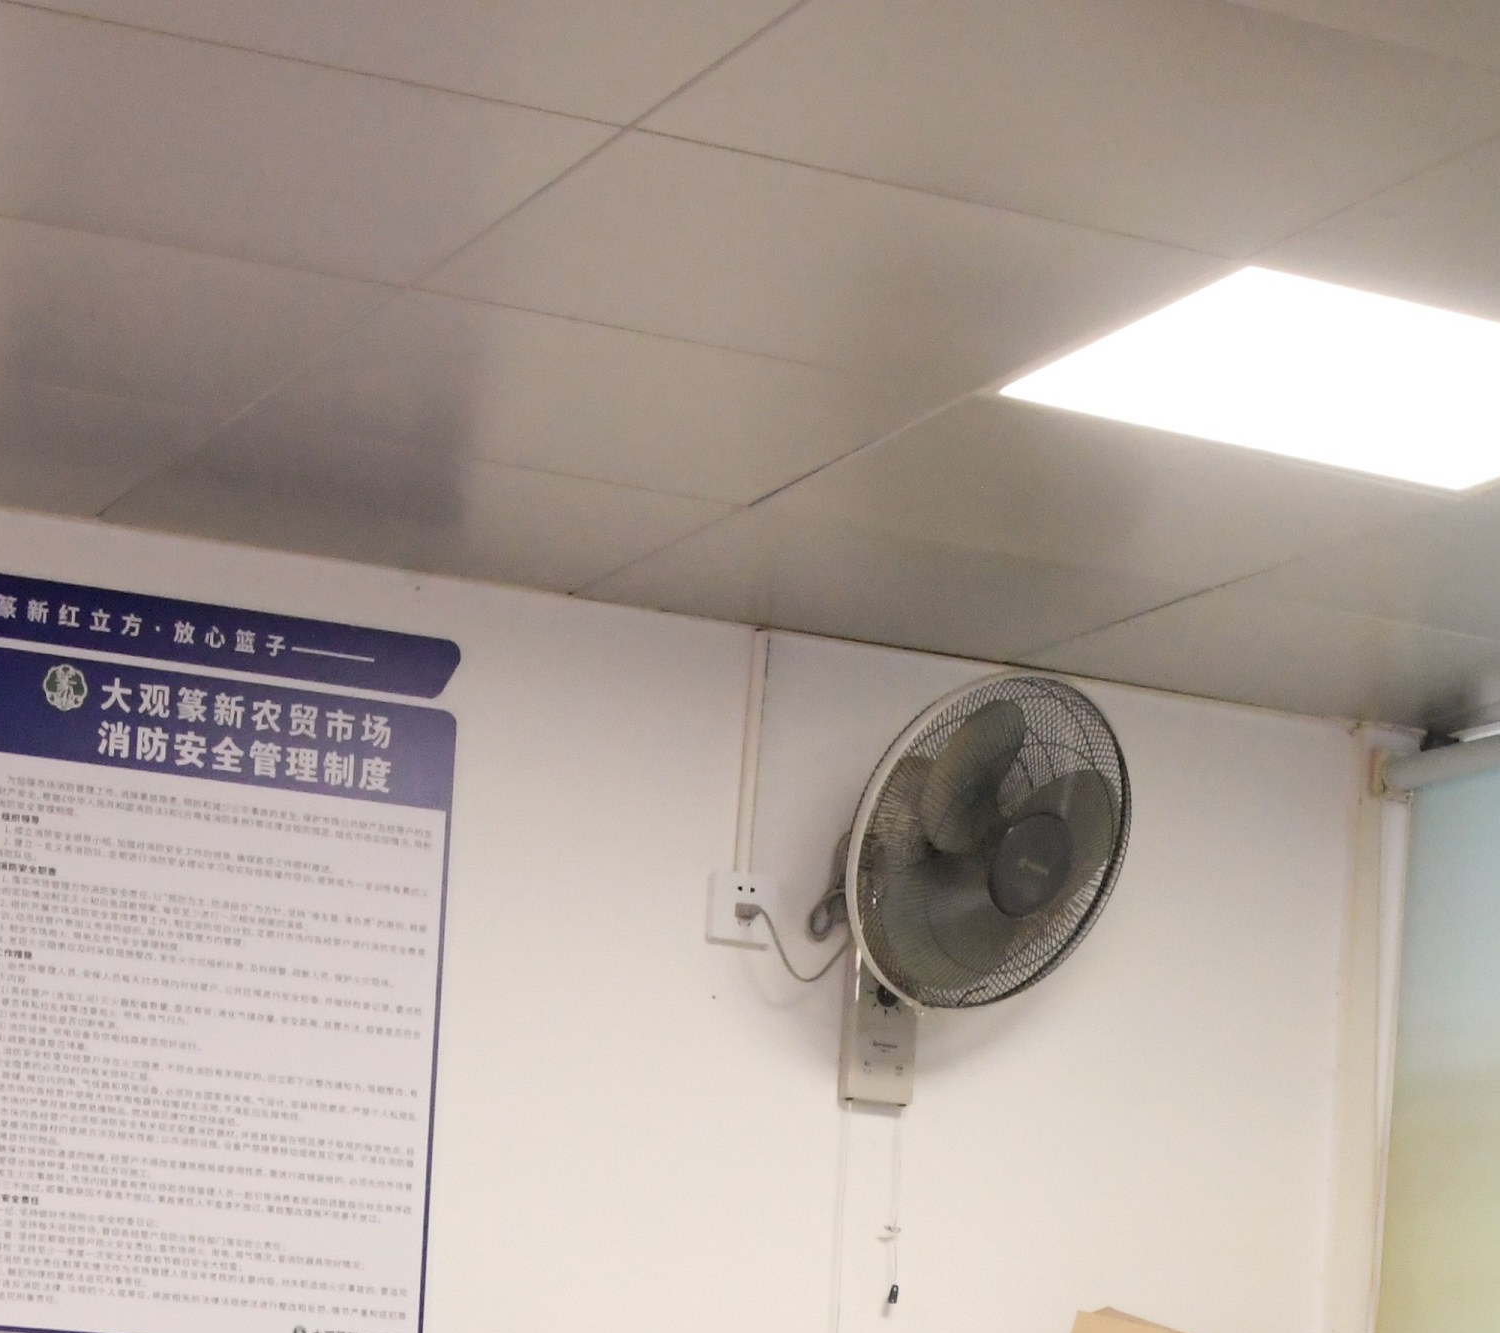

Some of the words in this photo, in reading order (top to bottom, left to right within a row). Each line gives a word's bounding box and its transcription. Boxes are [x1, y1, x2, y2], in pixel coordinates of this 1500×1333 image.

[99, 678, 393, 750] 大观篆新农贸市场
[97, 720, 392, 795] 消防安全管理制度
